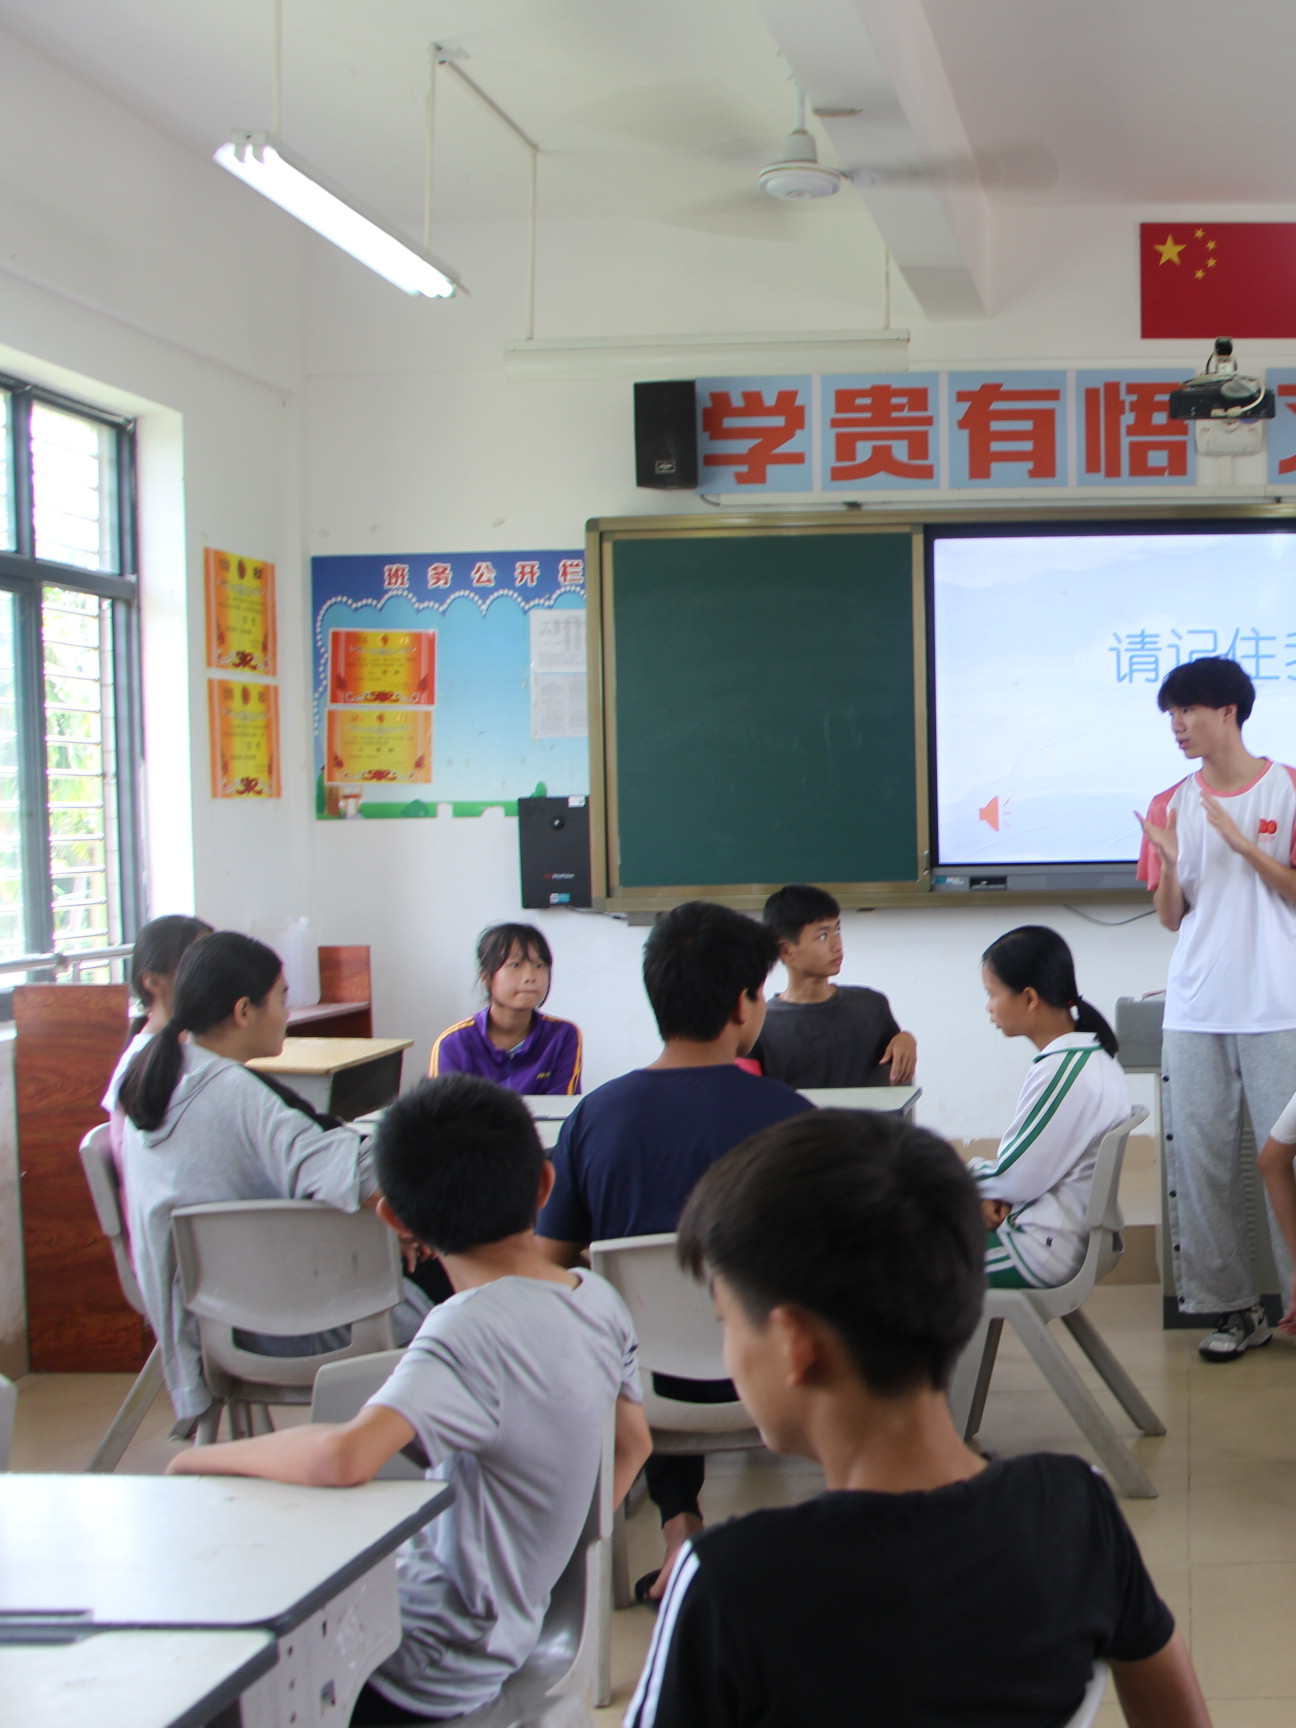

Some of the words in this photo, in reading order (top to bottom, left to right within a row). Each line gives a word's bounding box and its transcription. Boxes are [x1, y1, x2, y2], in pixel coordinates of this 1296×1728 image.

[704, 380, 1191, 485] 学贵有悟
[384, 559, 584, 589] 班务公开栏
